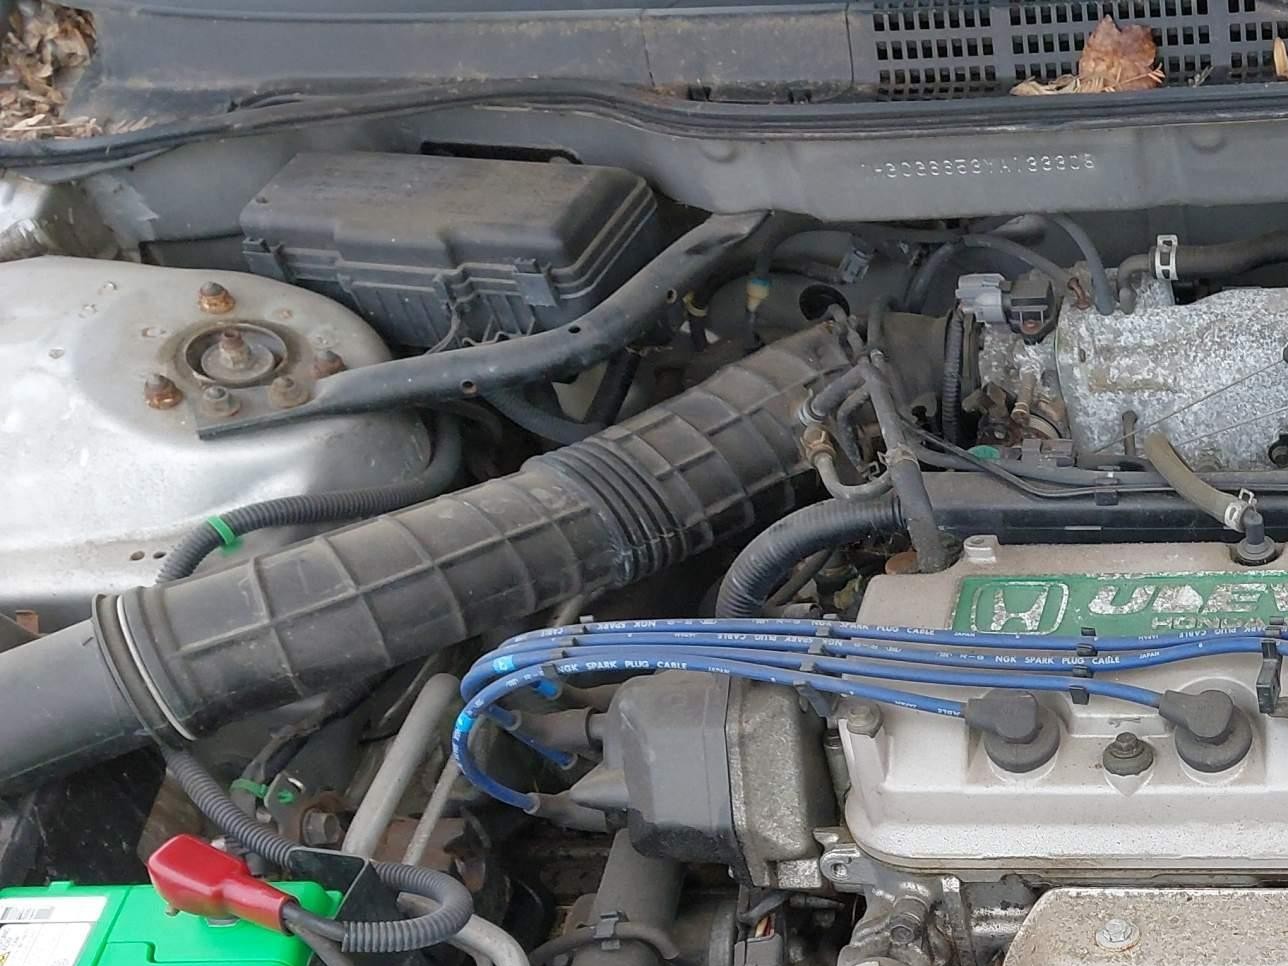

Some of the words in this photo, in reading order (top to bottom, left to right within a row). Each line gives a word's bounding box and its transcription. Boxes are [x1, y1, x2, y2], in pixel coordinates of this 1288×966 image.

[906, 627, 936, 636] CABLE
[995, 655, 1017, 664] NGK
[1024, 655, 1055, 664] SPARK
[1061, 656, 1085, 665] PLUG
[1091, 655, 1121, 665] CABLE
[1139, 650, 1161, 660] JAPAN
[586, 660, 618, 670] SPARK
[624, 660, 650, 669] PLUG
[656, 660, 688, 670] CABLE
